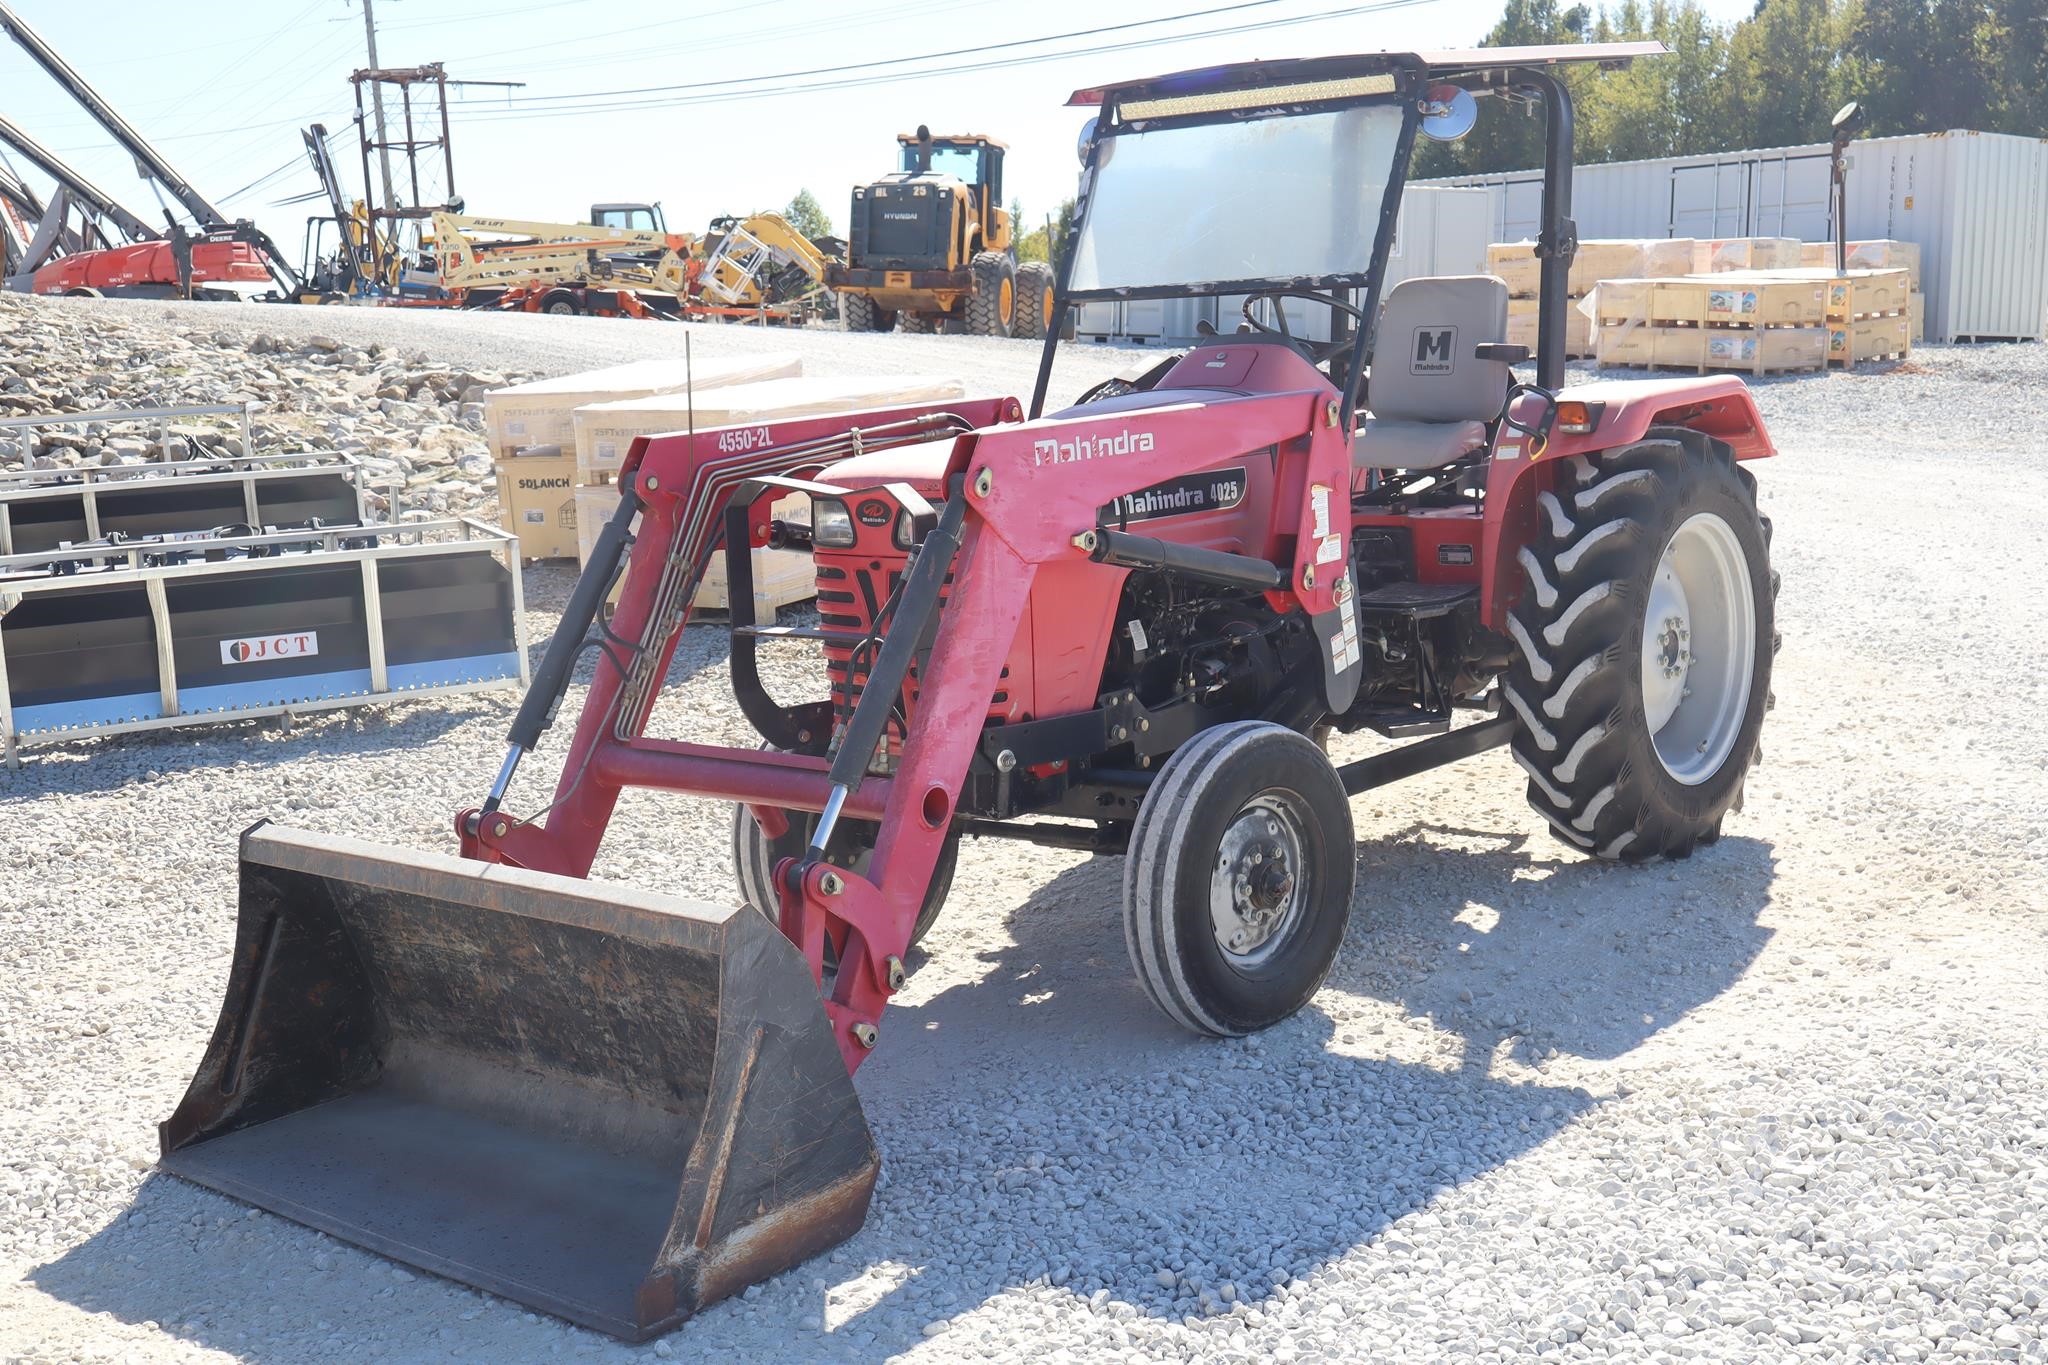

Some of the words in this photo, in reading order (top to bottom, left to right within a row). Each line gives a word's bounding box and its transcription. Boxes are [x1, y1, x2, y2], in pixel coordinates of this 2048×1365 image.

[884, 212, 918, 220] HYUNDAI
[209, 235, 233, 243] DEERE
[1414, 363, 1450, 371] Mahindra
[718, 426, 774, 453] 4550-2L
[1034, 429, 1154, 467] Mahindra
[1112, 487, 1204, 516] Mahindra
[1210, 480, 1238, 503] 4025
[255, 635, 310, 658] JCT
